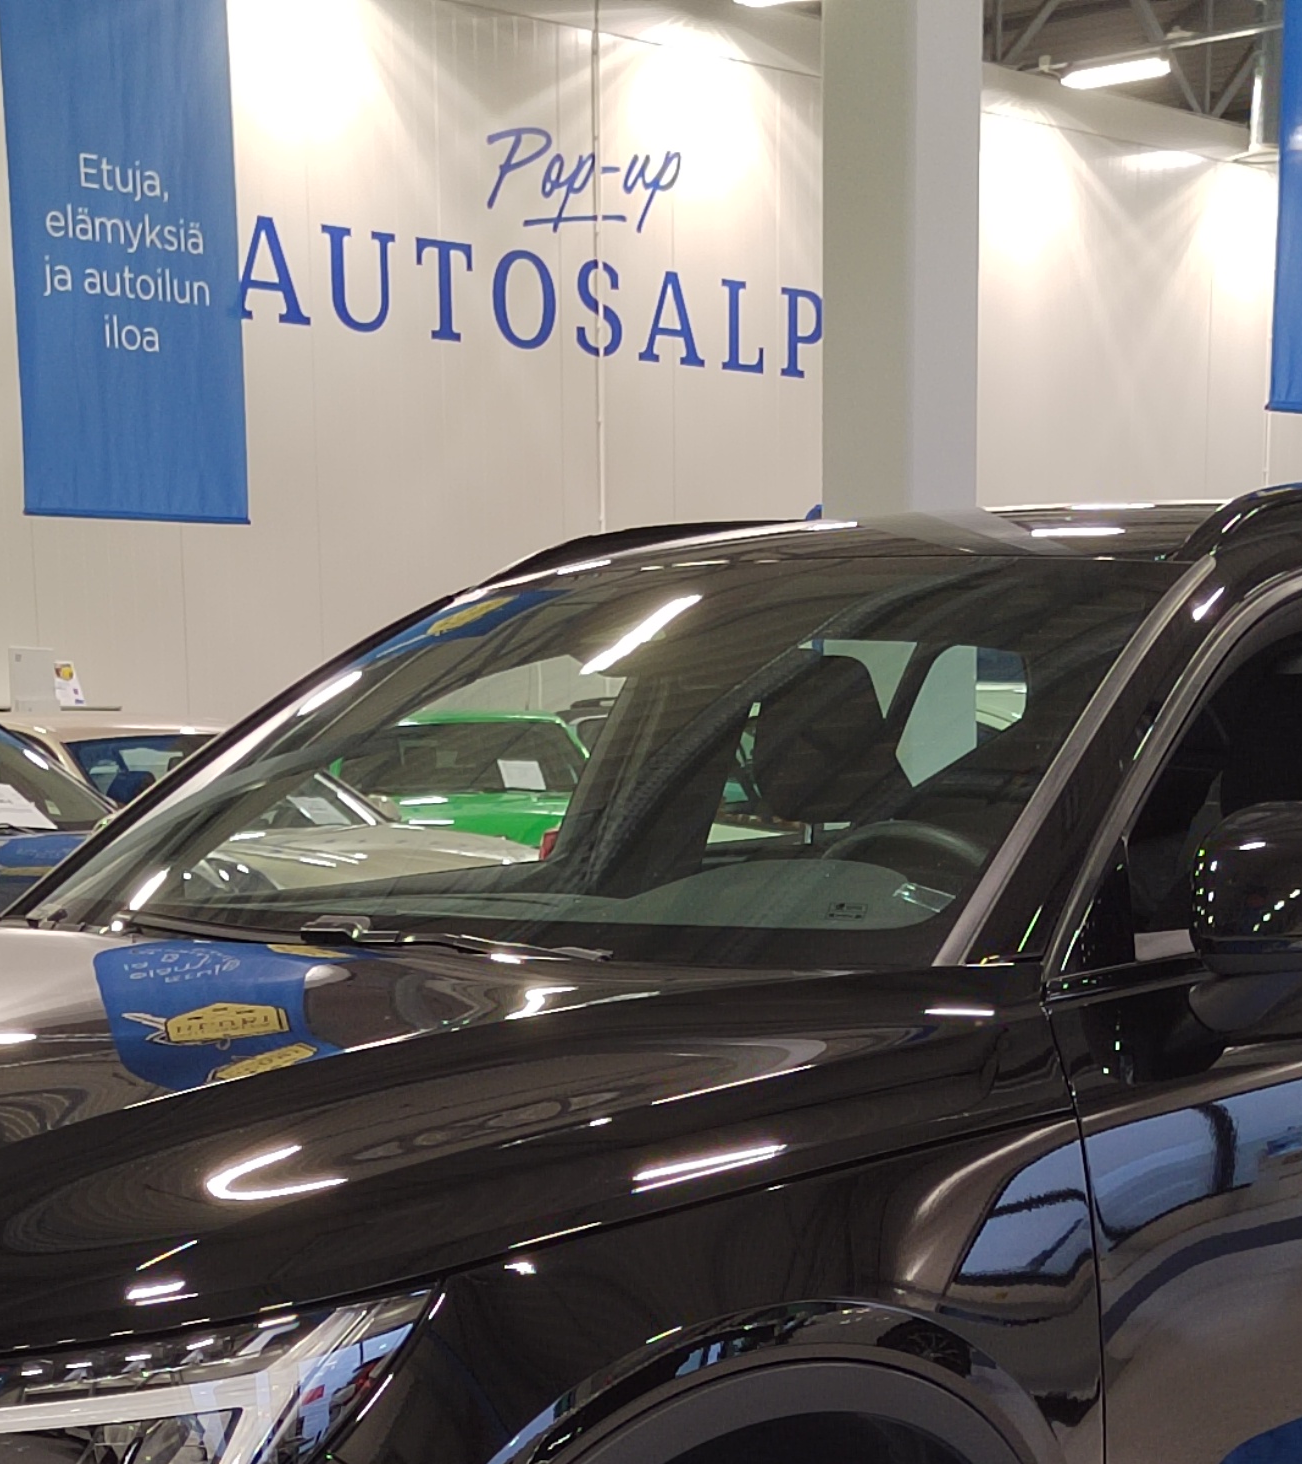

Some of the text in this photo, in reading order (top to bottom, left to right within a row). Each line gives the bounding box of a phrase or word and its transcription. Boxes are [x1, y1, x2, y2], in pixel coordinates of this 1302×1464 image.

[78, 152, 169, 203] Etuja,
[486, 126, 682, 234] Pop-up
[45, 202, 205, 255] elämyksiä
[43, 254, 211, 307] ja autoilun
[103, 313, 160, 353] iloa
